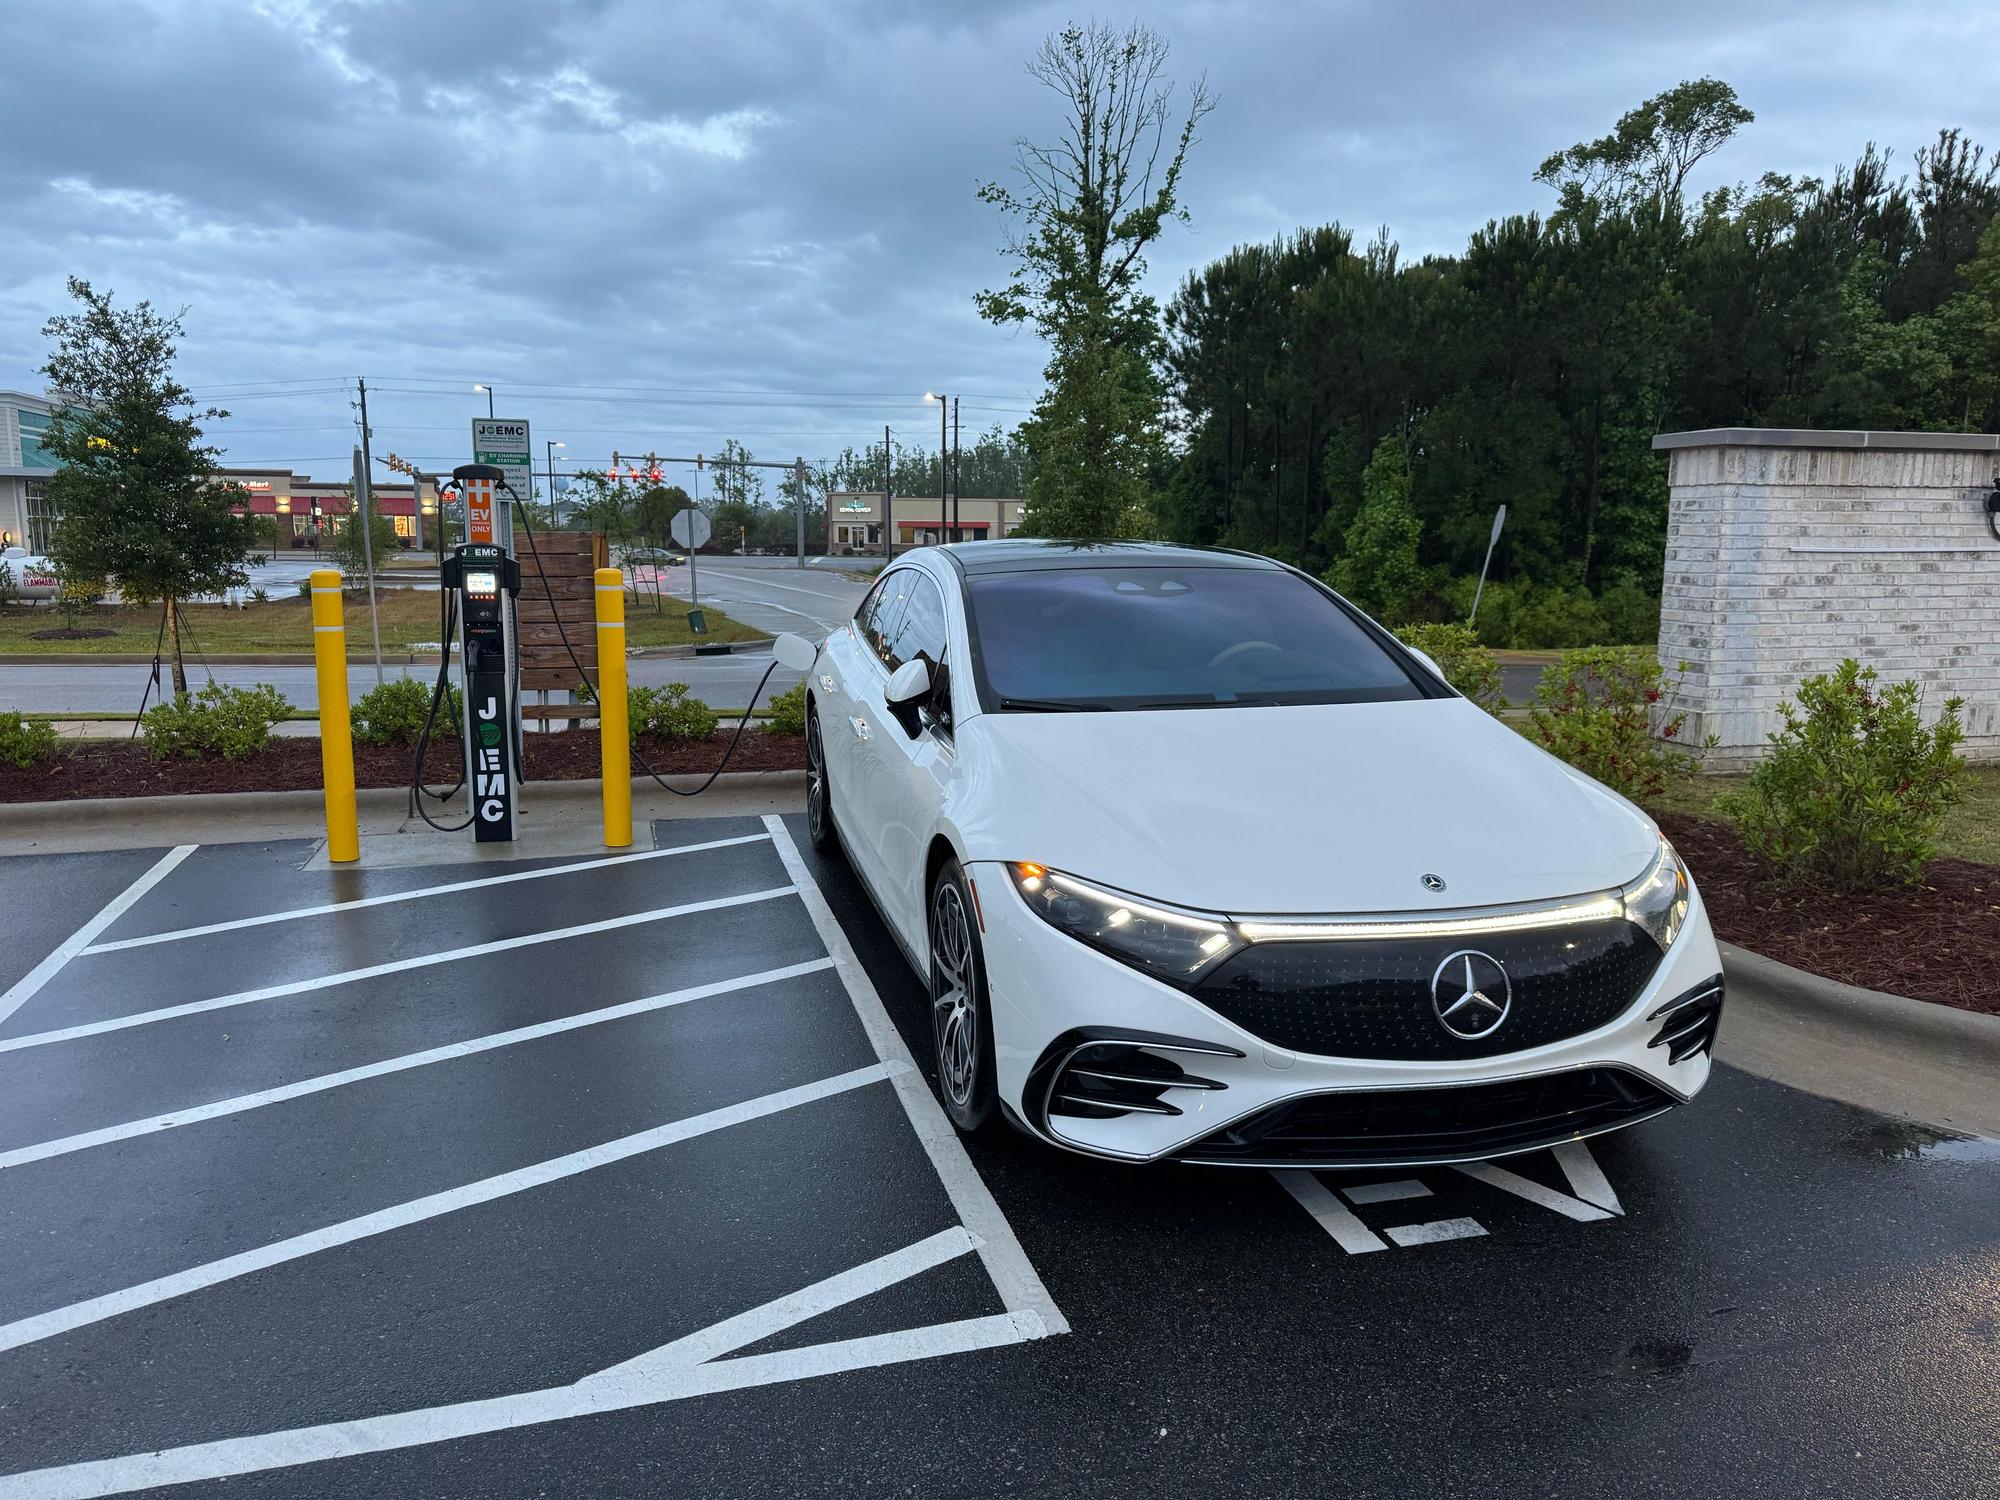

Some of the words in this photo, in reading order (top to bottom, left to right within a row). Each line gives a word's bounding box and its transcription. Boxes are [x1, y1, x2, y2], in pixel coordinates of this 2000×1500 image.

[478, 425, 524, 436] JOEMC
[248, 480, 269, 488] Mart
[470, 508, 490, 521] EV
[471, 525, 491, 533] ONLY
[1269, 1140, 1626, 1255] EV
